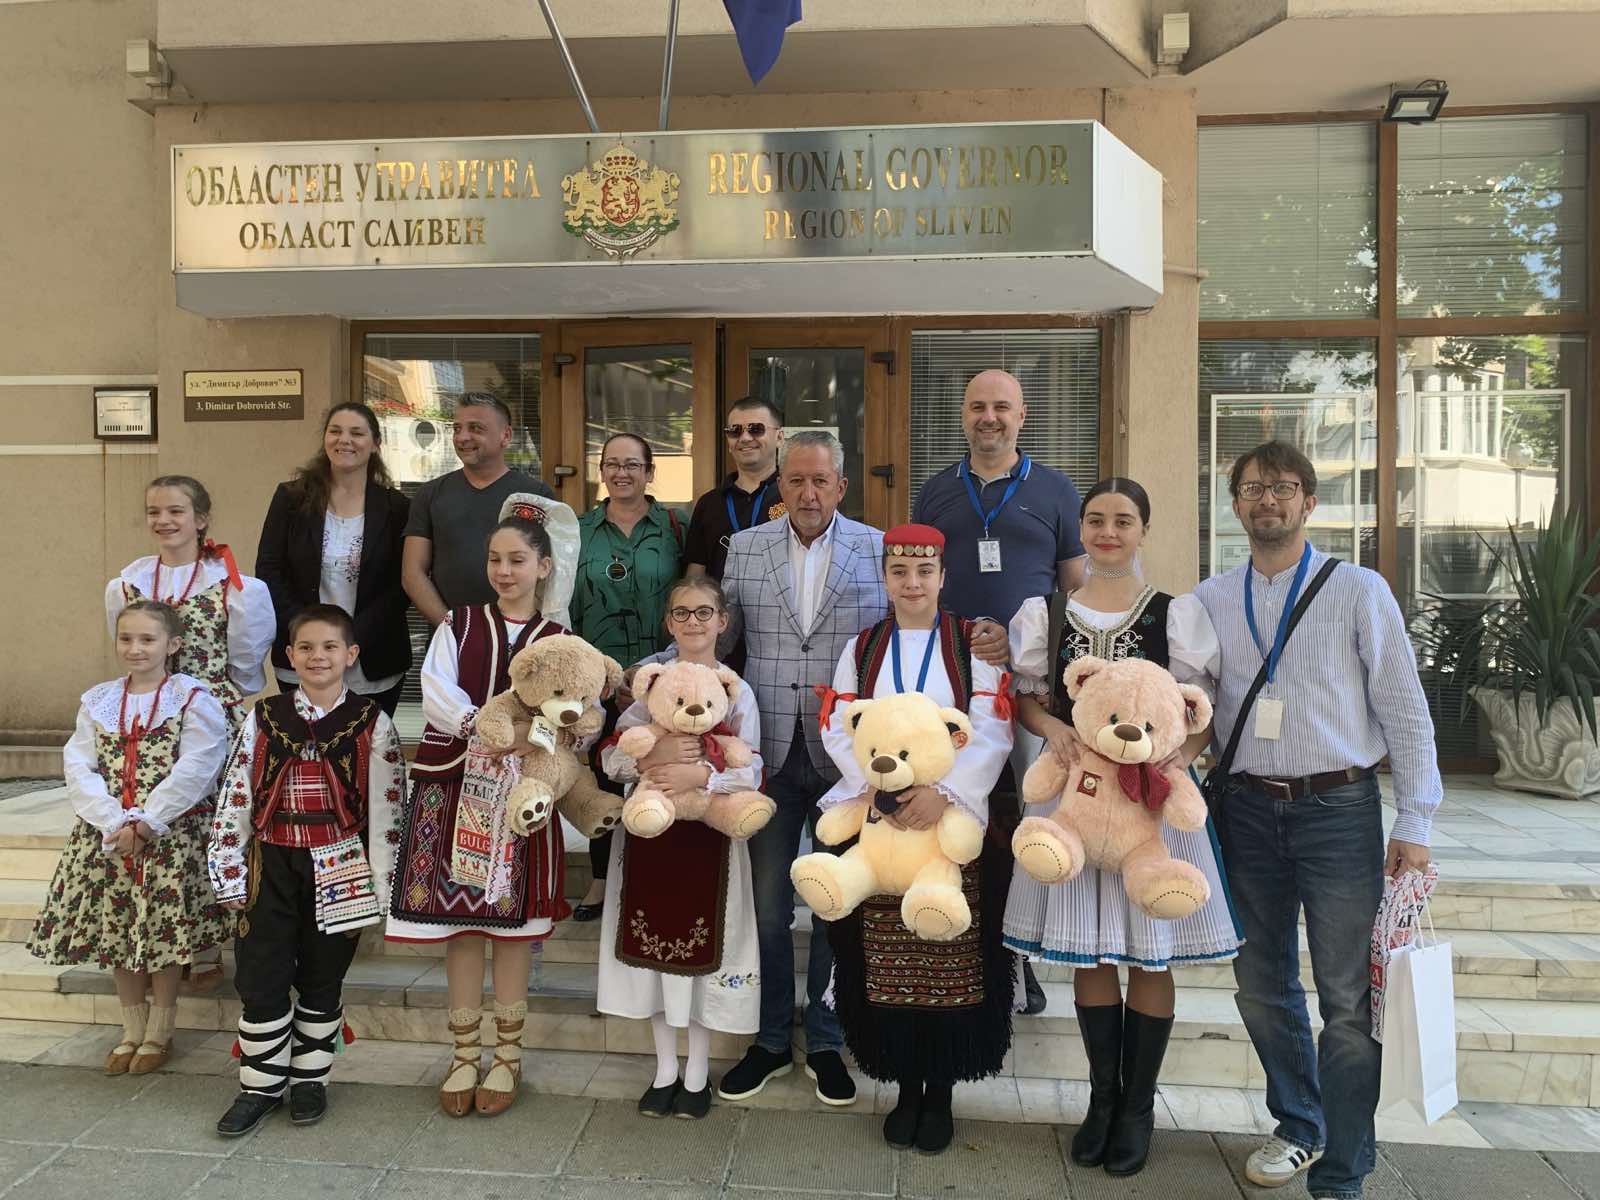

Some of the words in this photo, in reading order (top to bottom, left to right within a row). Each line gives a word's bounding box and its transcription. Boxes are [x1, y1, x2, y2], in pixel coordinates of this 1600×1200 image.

[185, 162, 344, 208] ОБЛАСТЕН
[353, 158, 542, 204] УПРАВИТЕЛ
[707, 149, 873, 196] REGIONAL
[885, 144, 1070, 192] GOVERNOR
[239, 219, 356, 251] ОБЛАСТ
[364, 215, 488, 248] СЛИВЕН
[763, 207, 865, 241] REGION
[873, 206, 907, 238] OF
[914, 204, 1013, 237] SLIVEN
[205, 402, 235, 410] Dimitar
[236, 401, 276, 410] Dobrovich
[277, 401, 291, 409] Str.
